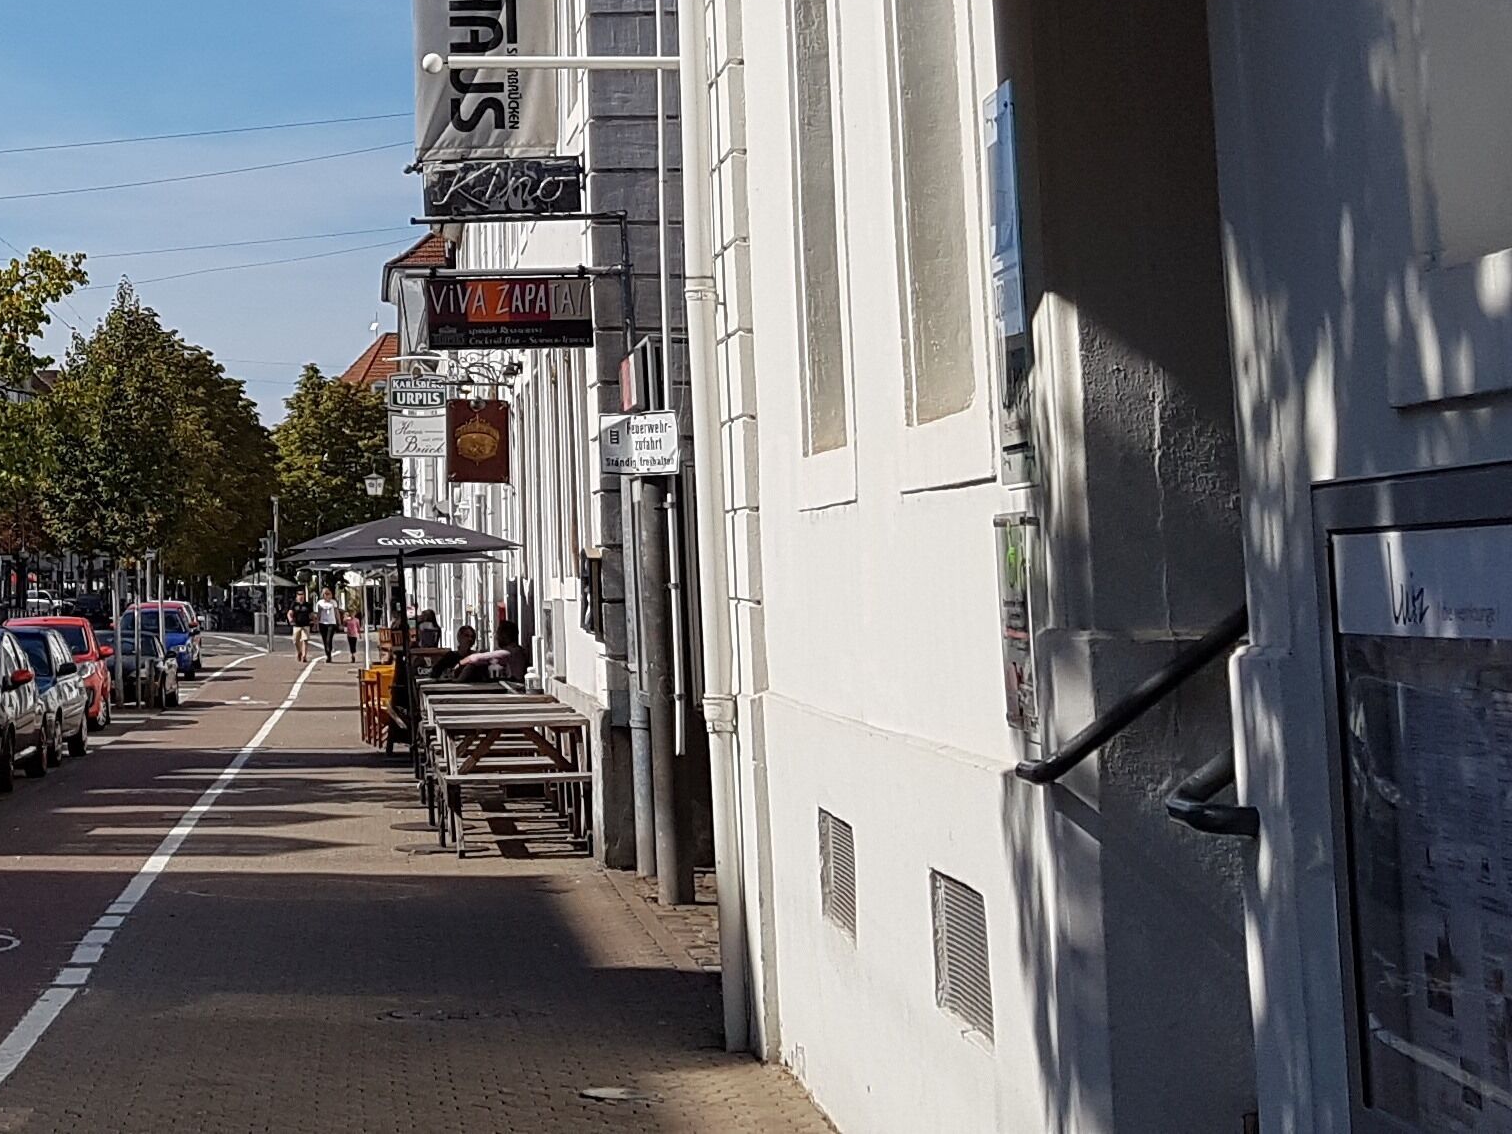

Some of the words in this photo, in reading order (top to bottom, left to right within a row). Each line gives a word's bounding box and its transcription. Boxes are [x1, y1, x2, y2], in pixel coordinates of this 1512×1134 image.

[506, 47, 522, 130] SRBRÜCKEN
[396, 392, 441, 405] URPILS
[626, 420, 672, 435] Feuerwehr-
[635, 436, 663, 451] zufahrt
[377, 537, 468, 546] GUINNESS
